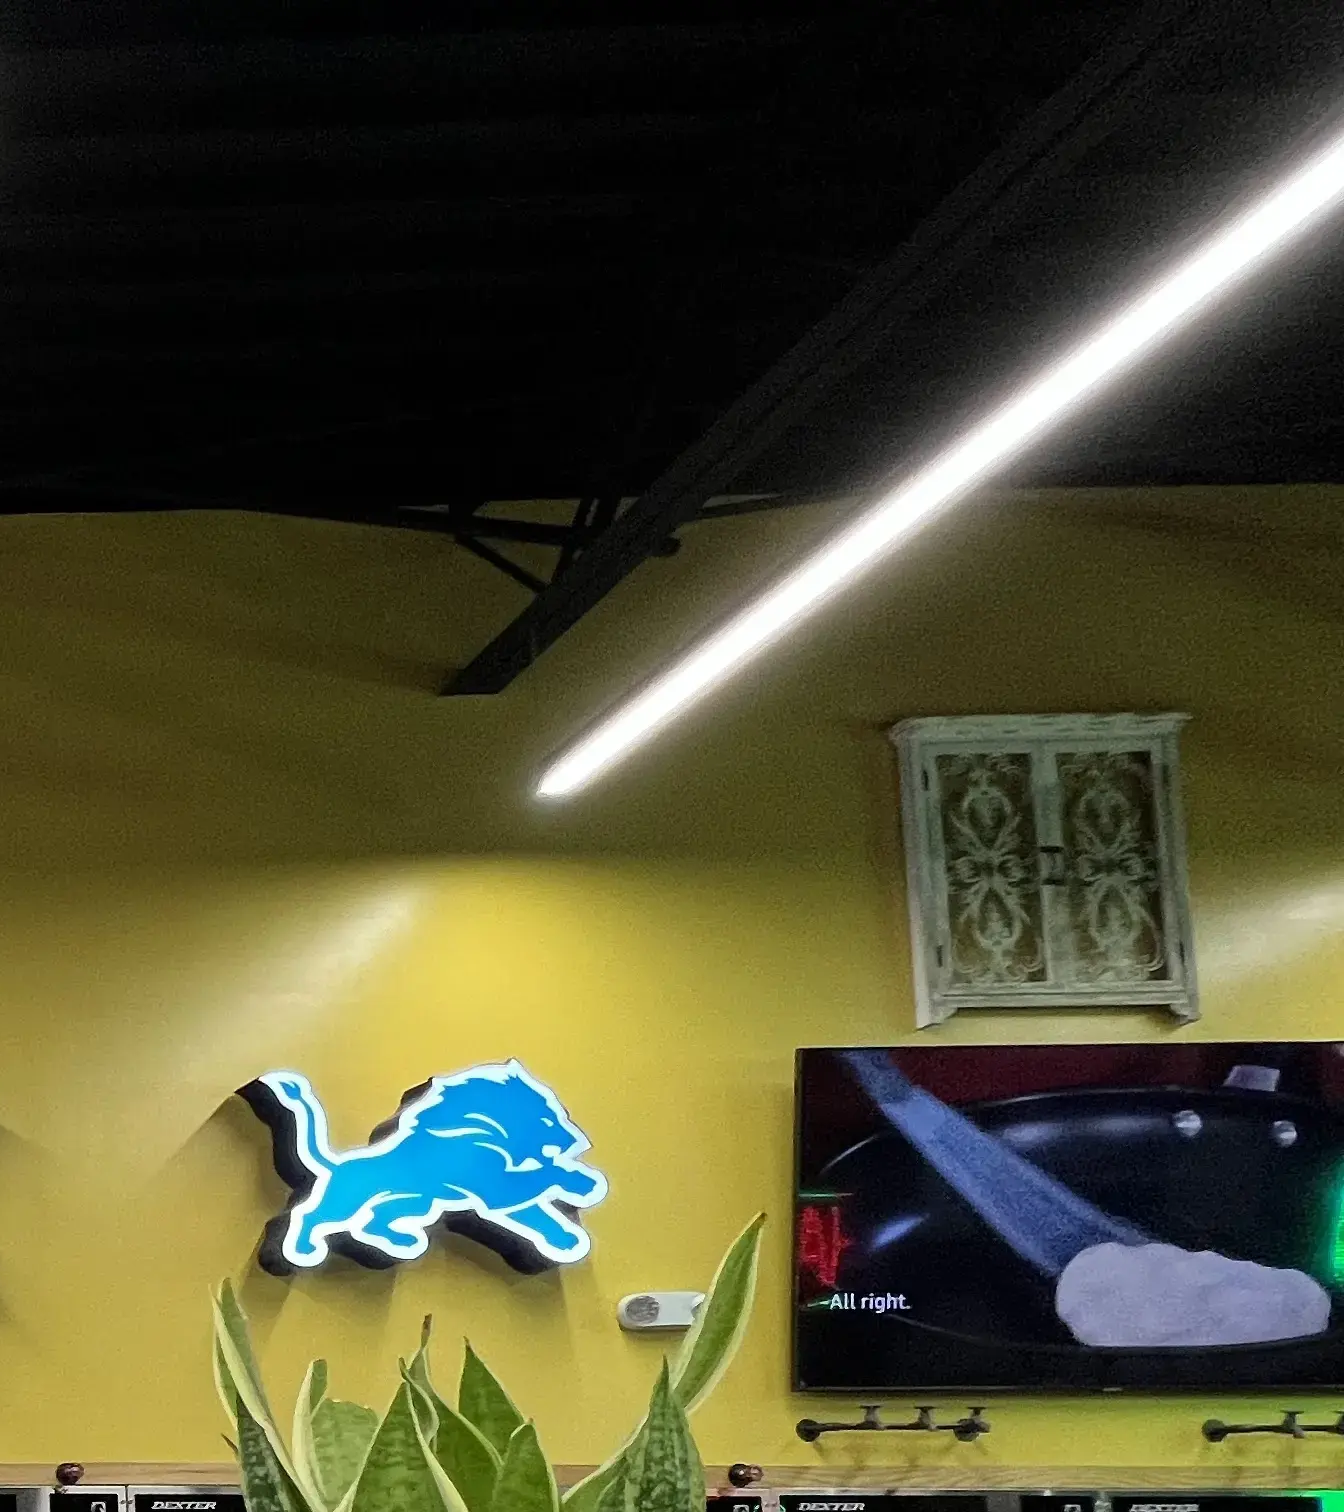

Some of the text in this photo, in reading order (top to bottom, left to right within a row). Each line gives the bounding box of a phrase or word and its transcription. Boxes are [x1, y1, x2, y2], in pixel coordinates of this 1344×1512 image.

[860, 1292, 912, 1314] right.
[150, 1501, 217, 1510] DEXTER
[797, 1502, 866, 1512] DEXTER
